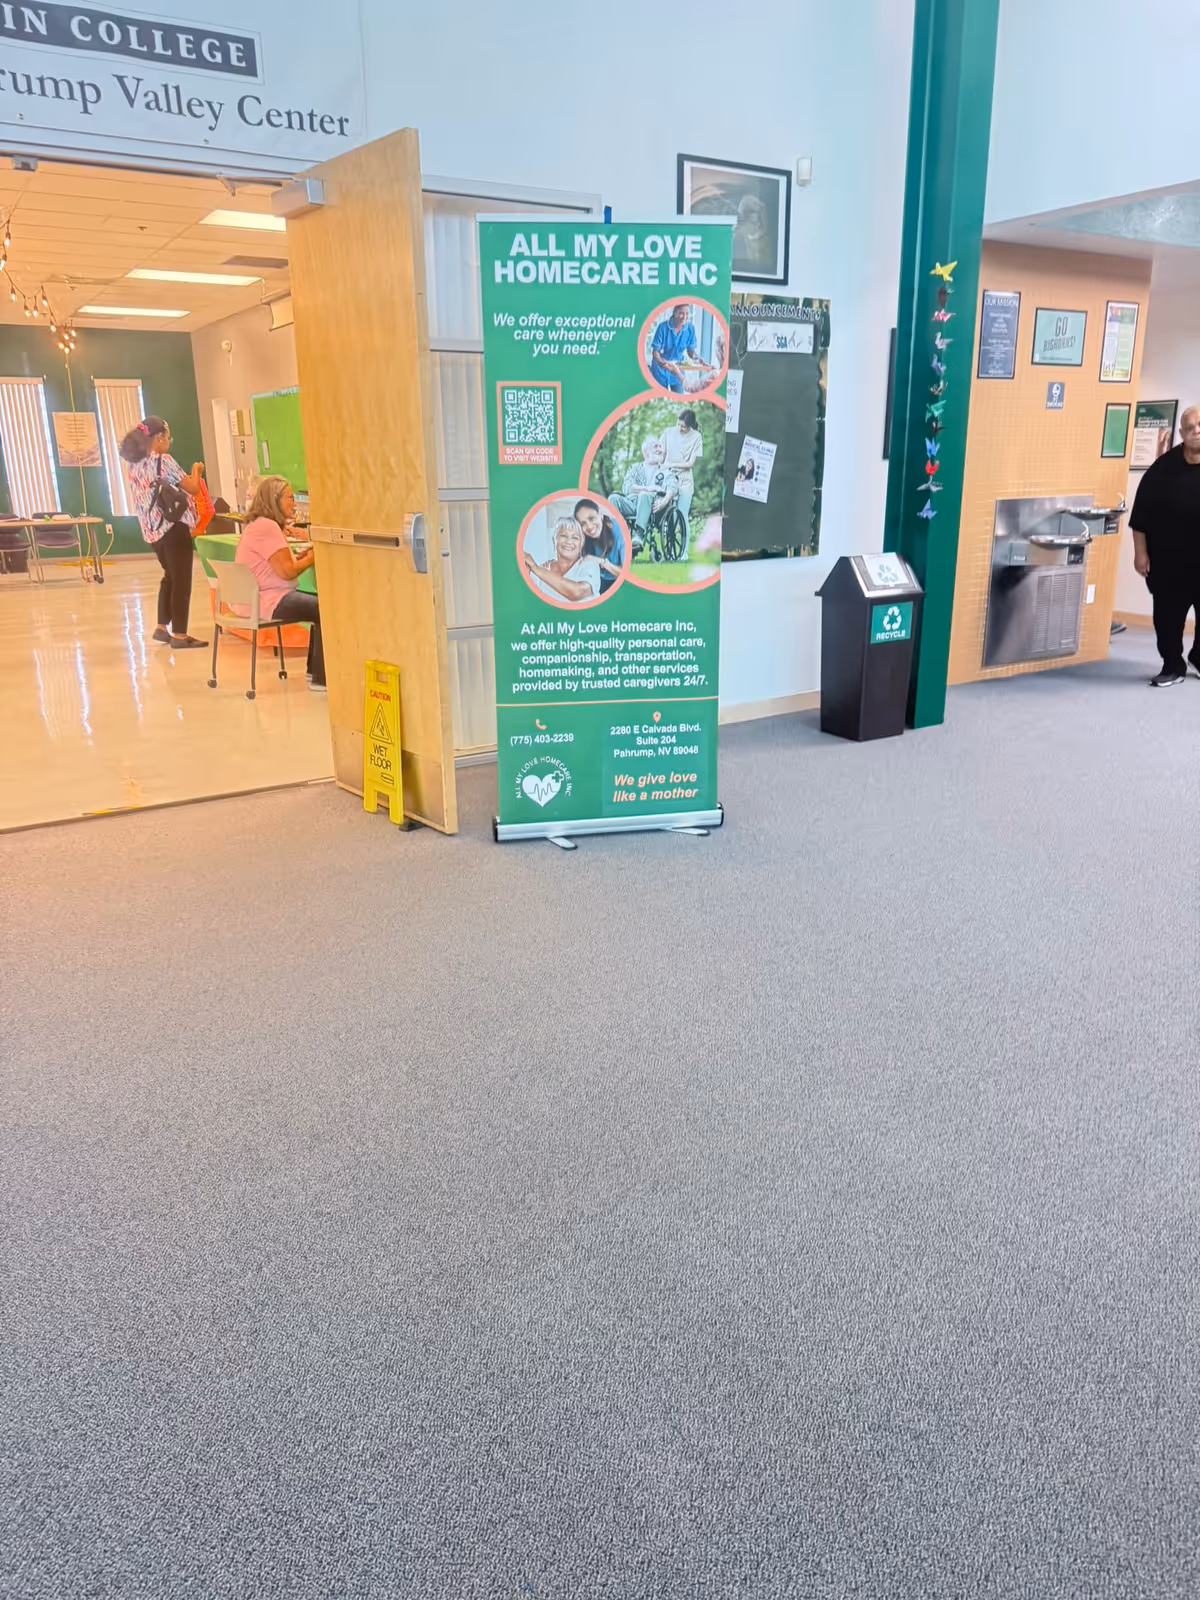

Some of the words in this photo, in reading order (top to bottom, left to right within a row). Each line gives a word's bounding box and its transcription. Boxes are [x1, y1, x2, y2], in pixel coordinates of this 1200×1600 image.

[70, 15, 248, 68] COLLEGE
[112, 73, 224, 131] Valley
[237, 94, 349, 137] Center
[509, 233, 565, 256] ALL
[575, 234, 619, 257] MY
[627, 235, 702, 258] LOVE
[494, 261, 659, 284] HOMECARE
[669, 262, 718, 286] INC
[494, 313, 515, 326] We
[519, 313, 552, 327] offer
[555, 314, 635, 329] exceptional
[1055, 317, 1068, 337] GO
[514, 329, 544, 340] care
[548, 329, 616, 341] whenever
[533, 343, 560, 357] you
[563, 342, 600, 354] need.
[521, 622, 535, 635] At
[537, 623, 553, 634] All
[557, 622, 575, 636] My
[578, 622, 608, 633] Love
[611, 622, 672, 632] Homecare
[675, 621, 697, 633] Inc,
[876, 630, 905, 640] RECYCLE
[511, 642, 527, 651] we
[530, 639, 556, 650] offer
[559, 639, 624, 651] high-quality
[628, 638, 677, 651] personal
[680, 638, 705, 649] care,
[522, 653, 612, 665] companionship,
[615, 651, 696, 663] transportation,
[519, 666, 594, 678] homemaking,
[598, 665, 619, 676] and
[622, 665, 650, 675] other
[653, 664, 699, 674] services
[512, 679, 562, 693] provided
[565, 679, 578, 691] by
[581, 678, 620, 689] trusted
[623, 677, 681, 689] caregivers
[684, 676, 708, 686] 24/7.
[370, 690, 391, 702] CAUTION
[610, 726, 631, 735] 2280
[634, 726, 639, 734] E
[641, 724, 677, 733] Calvada
[679, 724, 701, 732] Blvd.
[510, 736, 532, 746] (775)
[534, 734, 574, 743] 403-2239
[636, 737, 658, 745] Suite
[661, 736, 676, 744] 204
[373, 743, 387, 757] WET
[613, 748, 656, 758] Pahrump,
[658, 747, 671, 756] NV
[673, 746, 699, 755] 89048
[370, 755, 392, 771] FLOOR
[521, 758, 538, 773] LOVE
[540, 756, 571, 781] HOMECARE
[564, 783, 572, 796] INC
[614, 774, 635, 786] We
[638, 774, 665, 788] give
[669, 772, 697, 783] love
[613, 790, 636, 803] like
[640, 792, 647, 800] a
[651, 788, 699, 800] mother
